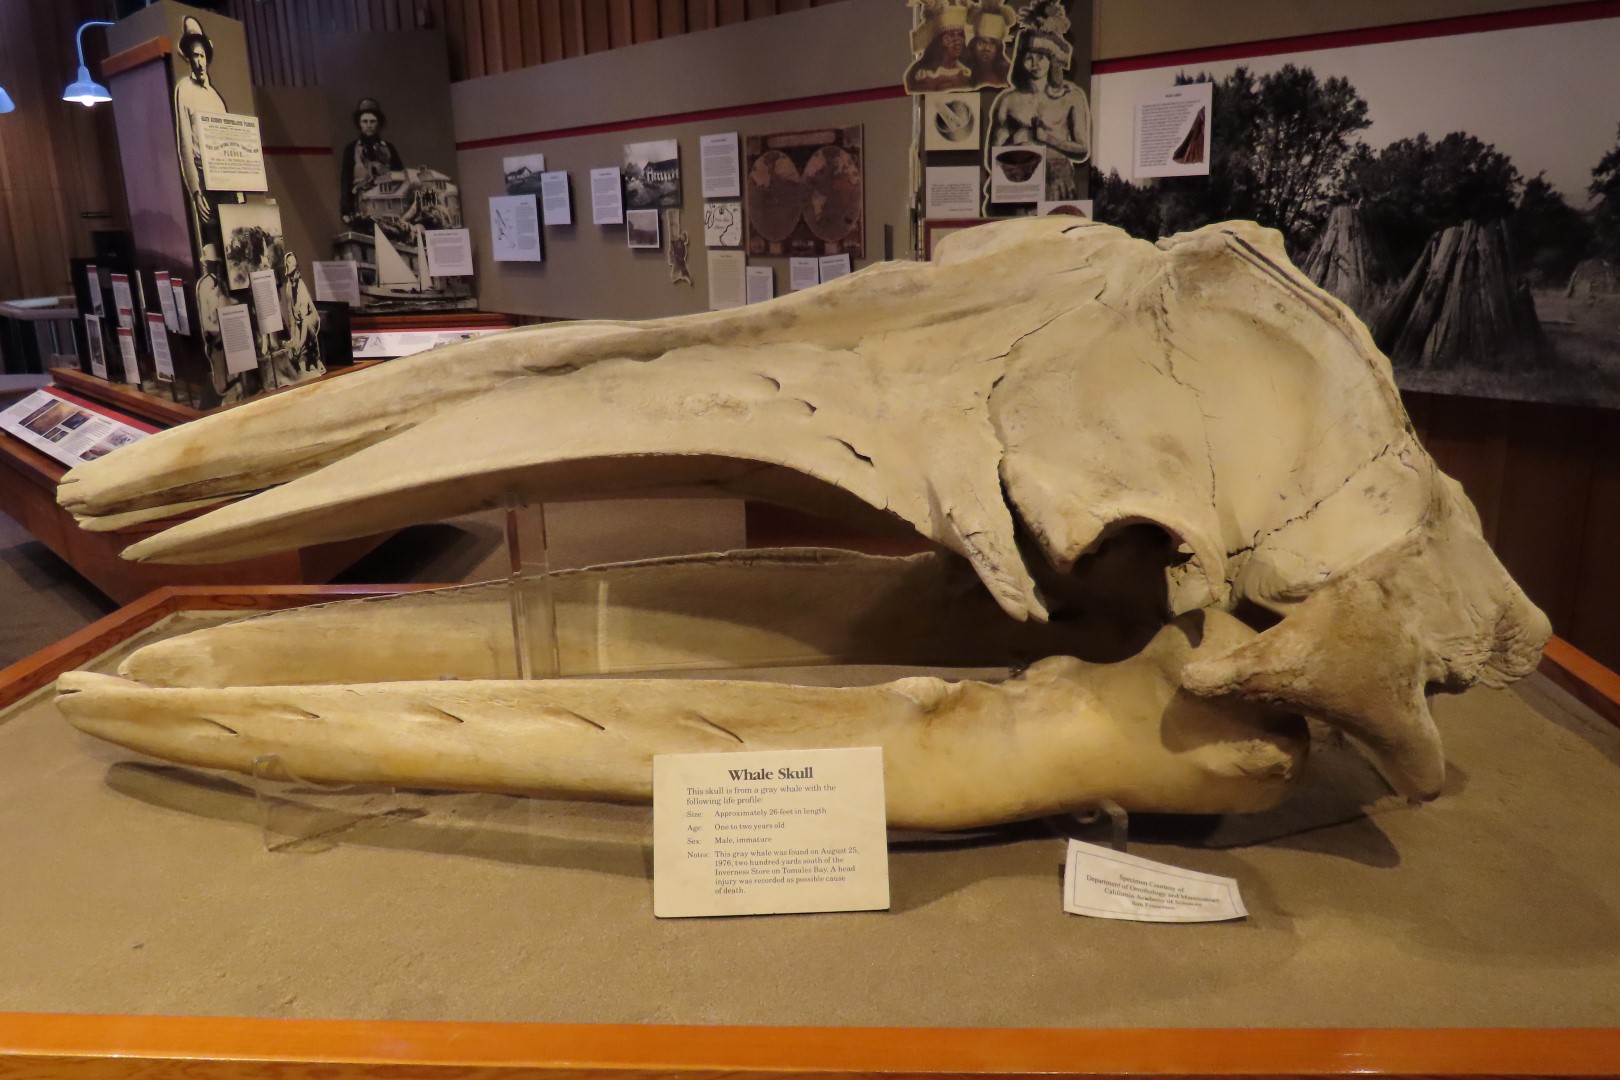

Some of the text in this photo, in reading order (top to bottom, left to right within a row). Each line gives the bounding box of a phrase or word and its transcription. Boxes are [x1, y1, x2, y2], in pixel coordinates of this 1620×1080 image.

[728, 767, 813, 781] Whale Skull
[687, 787, 704, 795] This
[705, 787, 724, 795] skull
[734, 786, 752, 794] from
[760, 787, 778, 795] gray
[780, 785, 803, 793] whale
[804, 784, 822, 792] with
[823, 783, 837, 791] the
[686, 795, 764, 806] following life profile:
[686, 810, 704, 818] Size:
[714, 809, 768, 818] Approximately
[803, 807, 827, 815] length
[687, 824, 703, 832] Age:
[714, 823, 730, 831] One
[753, 823, 773, 831] years
[686, 837, 702, 845] Sex:
[687, 851, 710, 859] Notes:
[714, 850, 731, 858] This
[732, 851, 749, 859] gray
[750, 849, 772, 857] whale
[788, 848, 809, 856] found
[820, 847, 846, 855] August
[848, 846, 860, 855] 25,
[715, 859, 734, 867] 1976,
[802, 857, 823, 865] south
[823, 856, 831, 864] of
[750, 867, 770, 875] Store
[782, 866, 812, 874] Tomales
[813, 866, 829, 874] Bay.
[830, 865, 837, 873] A
[715, 878, 737, 886] injury
[795, 875, 825, 884] possible
[1086, 874, 1121, 887] Department
[1129, 885, 1166, 898] Ornithology
[1119, 874, 1148, 886] Specimen
[1148, 881, 1175, 892] Courtesy
[1104, 887, 1135, 899] California
